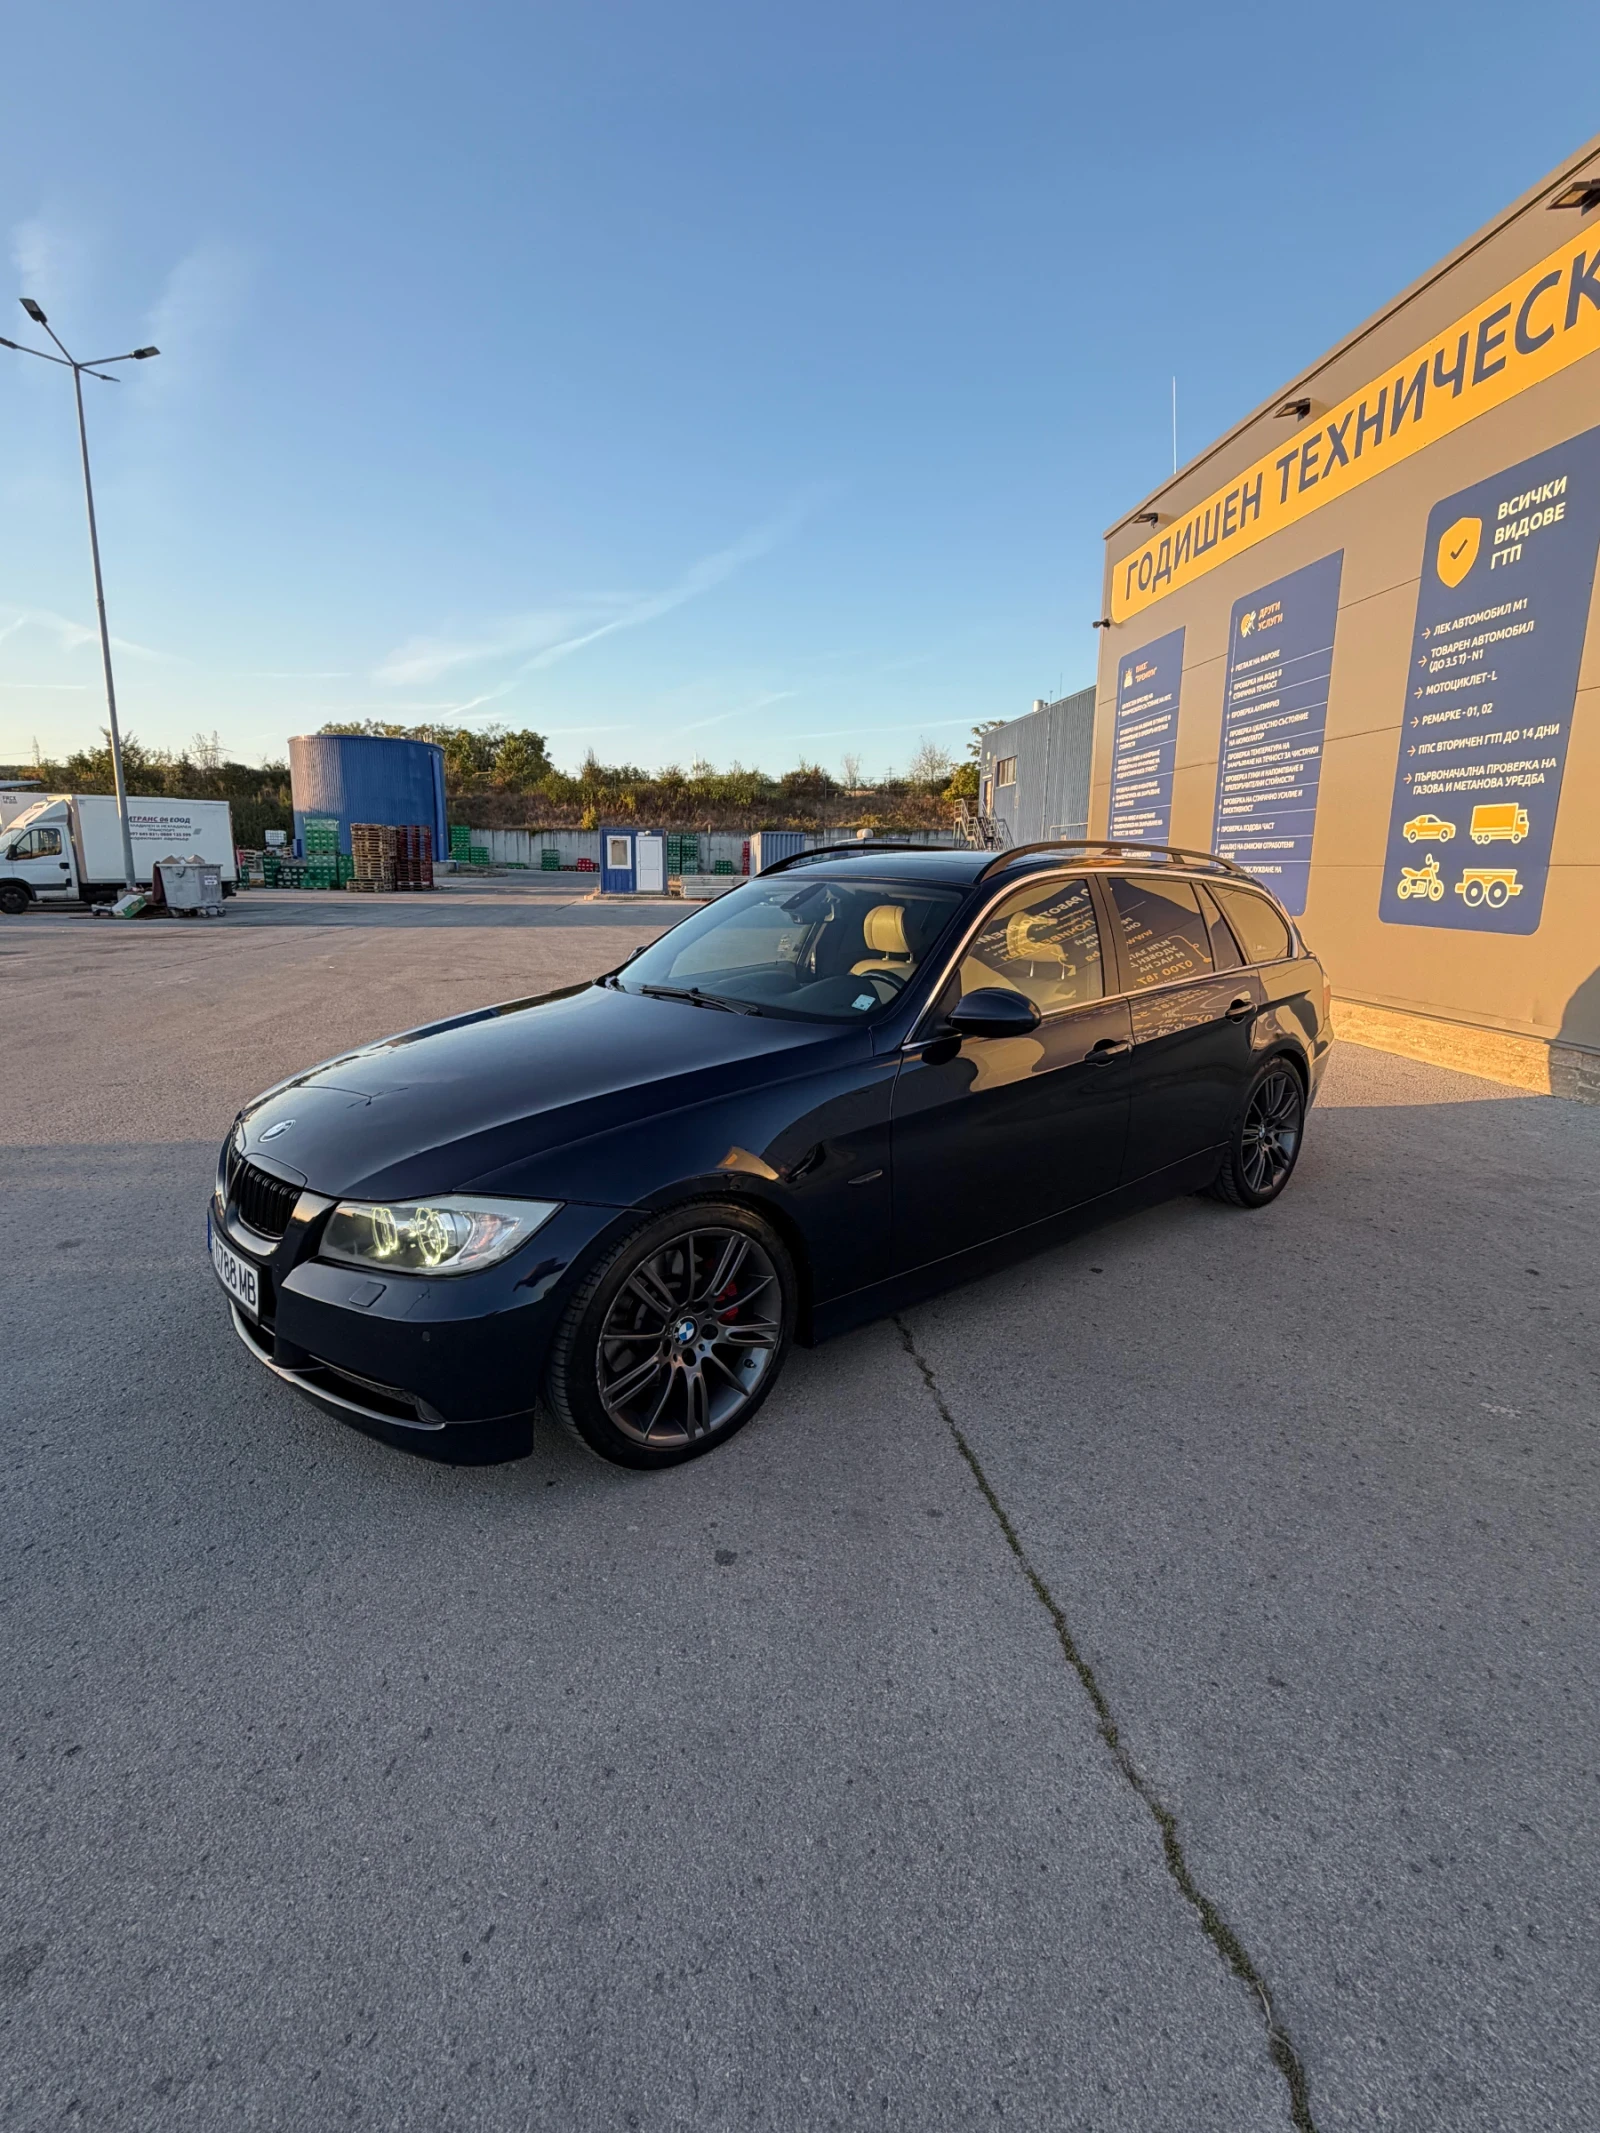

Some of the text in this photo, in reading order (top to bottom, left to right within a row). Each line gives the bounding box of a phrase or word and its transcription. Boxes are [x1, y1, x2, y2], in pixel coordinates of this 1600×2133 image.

[1125, 248, 1600, 601] ГОДИШЕН ТЕХНИЧЕСК
[1497, 475, 1568, 520] ВСИЧКИ
[1493, 502, 1566, 545] ВИДОВЕ
[1490, 543, 1522, 570] ГТП
[1257, 612, 1283, 632] УСЛУГИ
[1258, 600, 1281, 620] ДРУГИ
[1433, 621, 1451, 636] ЛЕК
[1452, 602, 1511, 628] АВТОМОБИЛ
[1431, 620, 1535, 659] ТОВАРЕН АВТОМОБИЛ
[1421, 708, 1461, 726] РЕМАРКЕ
[1418, 723, 1560, 755] ППС ВТОРИЧЕН ГТП ДО 14 ДНИ
[1412, 772, 1545, 796] ГАЗОВА И МЕТАНОВА УРЕДБА
[1414, 757, 1557, 783] ПЪРВОНАЧАЛНА ПРОВЕРКА НА
[239, 1263, 256, 1307] MB
